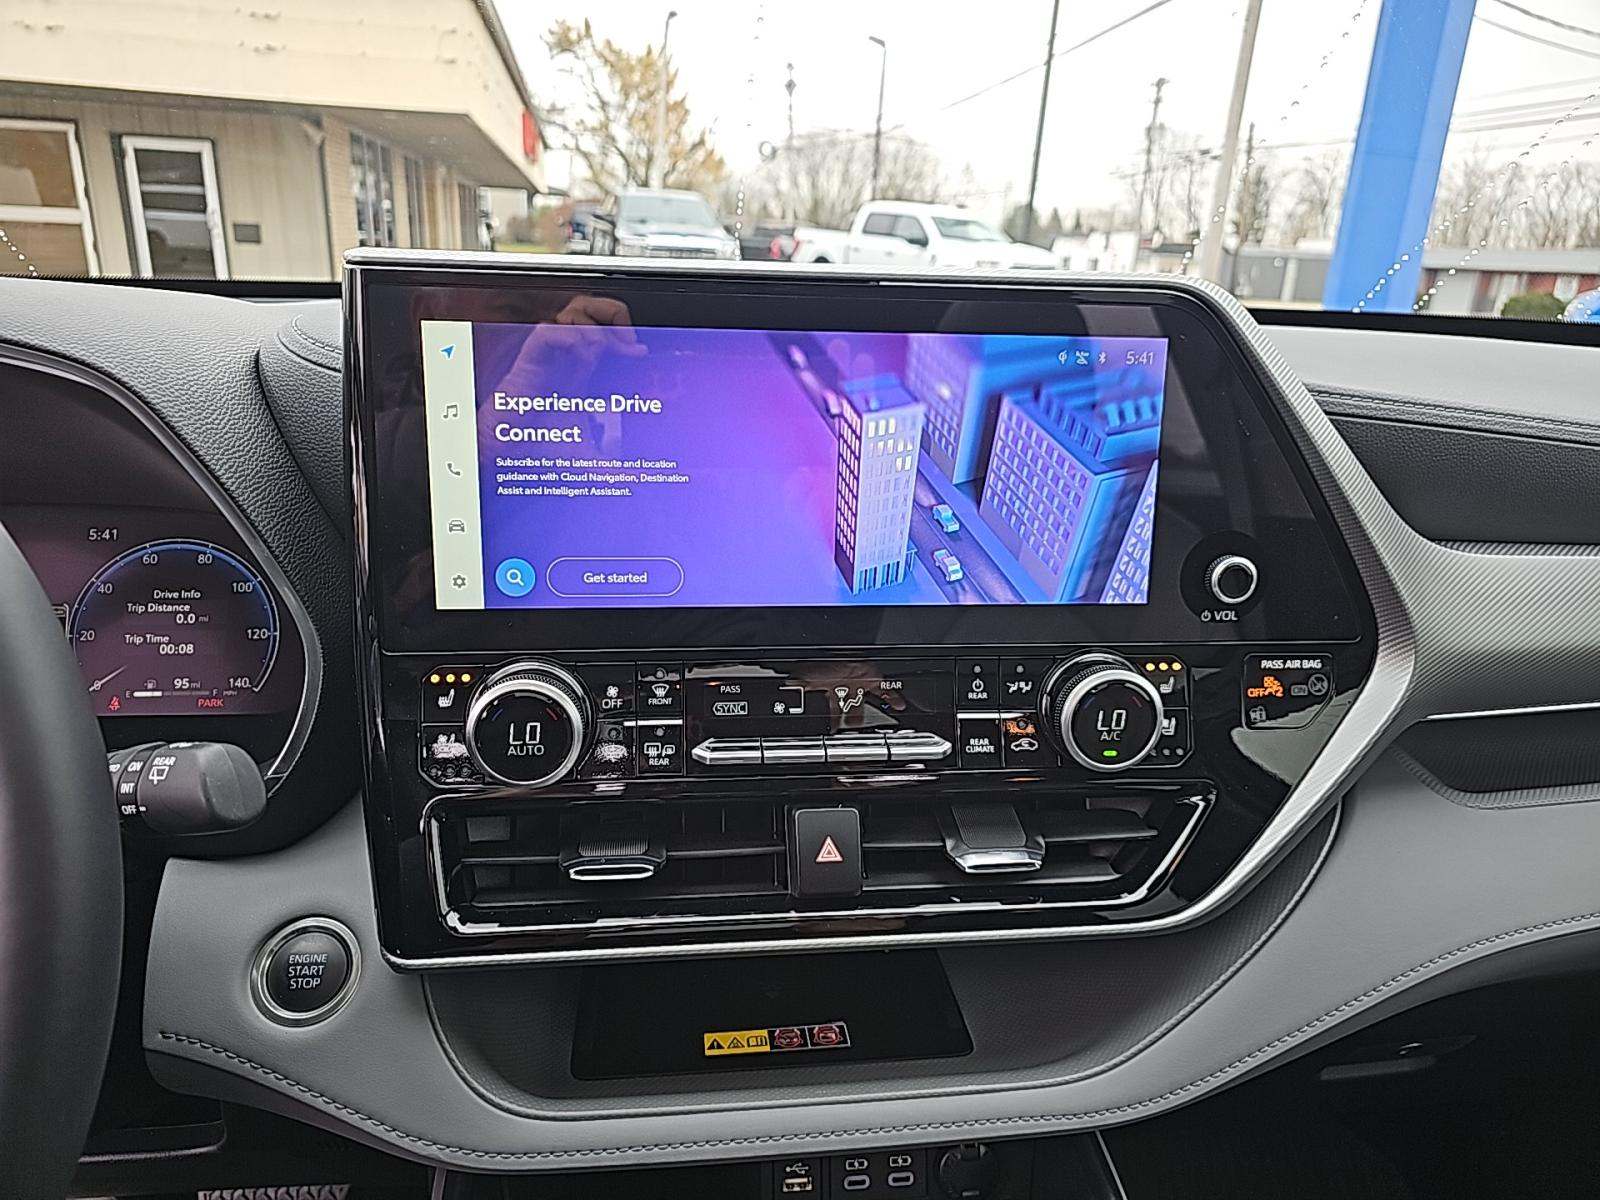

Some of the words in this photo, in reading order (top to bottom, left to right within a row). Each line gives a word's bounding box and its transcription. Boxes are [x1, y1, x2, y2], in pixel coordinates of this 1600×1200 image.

[1125, 351, 1154, 365] 5:41
[494, 393, 606, 415] Experience
[610, 395, 662, 414] Drive
[495, 423, 582, 443] Connect
[496, 457, 540, 467] Subscribe
[541, 458, 554, 467] for
[555, 458, 570, 467] the
[572, 458, 597, 468] latest
[598, 460, 622, 468] route
[623, 459, 641, 468] and
[642, 459, 677, 469] location
[496, 472, 539, 483] guidance
[540, 473, 559, 481] with
[560, 472, 588, 482] Cloud
[589, 473, 639, 484] Navigation,
[640, 473, 690, 483] Destination
[497, 486, 524, 495] Assist
[524, 487, 542, 495] and
[543, 487, 589, 497] Intelligent
[590, 487, 632, 496] Assistant.
[88, 528, 118, 541] 5:41
[142, 553, 158, 565] 60
[197, 553, 213, 565] 80
[583, 572, 606, 584] Get
[607, 572, 648, 584] started
[97, 582, 113, 594] 40
[232, 581, 252, 593] 100
[153, 589, 180, 599] Drive
[181, 589, 201, 599] Info
[127, 603, 146, 614] Trip
[147, 603, 191, 612] Distance
[176, 613, 196, 624] 0.0
[1214, 610, 1238, 621] VOL
[79, 630, 95, 641] 20
[124, 634, 144, 645] Trip
[145, 633, 170, 643] Time
[246, 628, 268, 640] 120
[159, 643, 194, 655] 00:08
[1261, 660, 1284, 669] PASS
[1284, 660, 1301, 669] AIR
[1302, 660, 1322, 669] BAG
[173, 678, 190, 689] 95
[228, 677, 249, 688] 140
[880, 681, 902, 690] REAR
[720, 684, 741, 694] PASS
[1247, 688, 1265, 697] OFF
[198, 698, 224, 708] PARK
[602, 699, 623, 709] OFF
[716, 702, 746, 714] SYNC
[969, 738, 989, 746] REAR
[1100, 731, 1121, 742] A/C
[507, 745, 545, 756] AUTO
[965, 745, 995, 753] CLIMATE
[152, 757, 176, 766] REAR
[648, 758, 670, 766] REAR
[120, 782, 135, 794] INT
[121, 804, 137, 815] OFF
[288, 953, 328, 964] ENGINE
[288, 965, 325, 977] START
[289, 978, 321, 989] STOP
